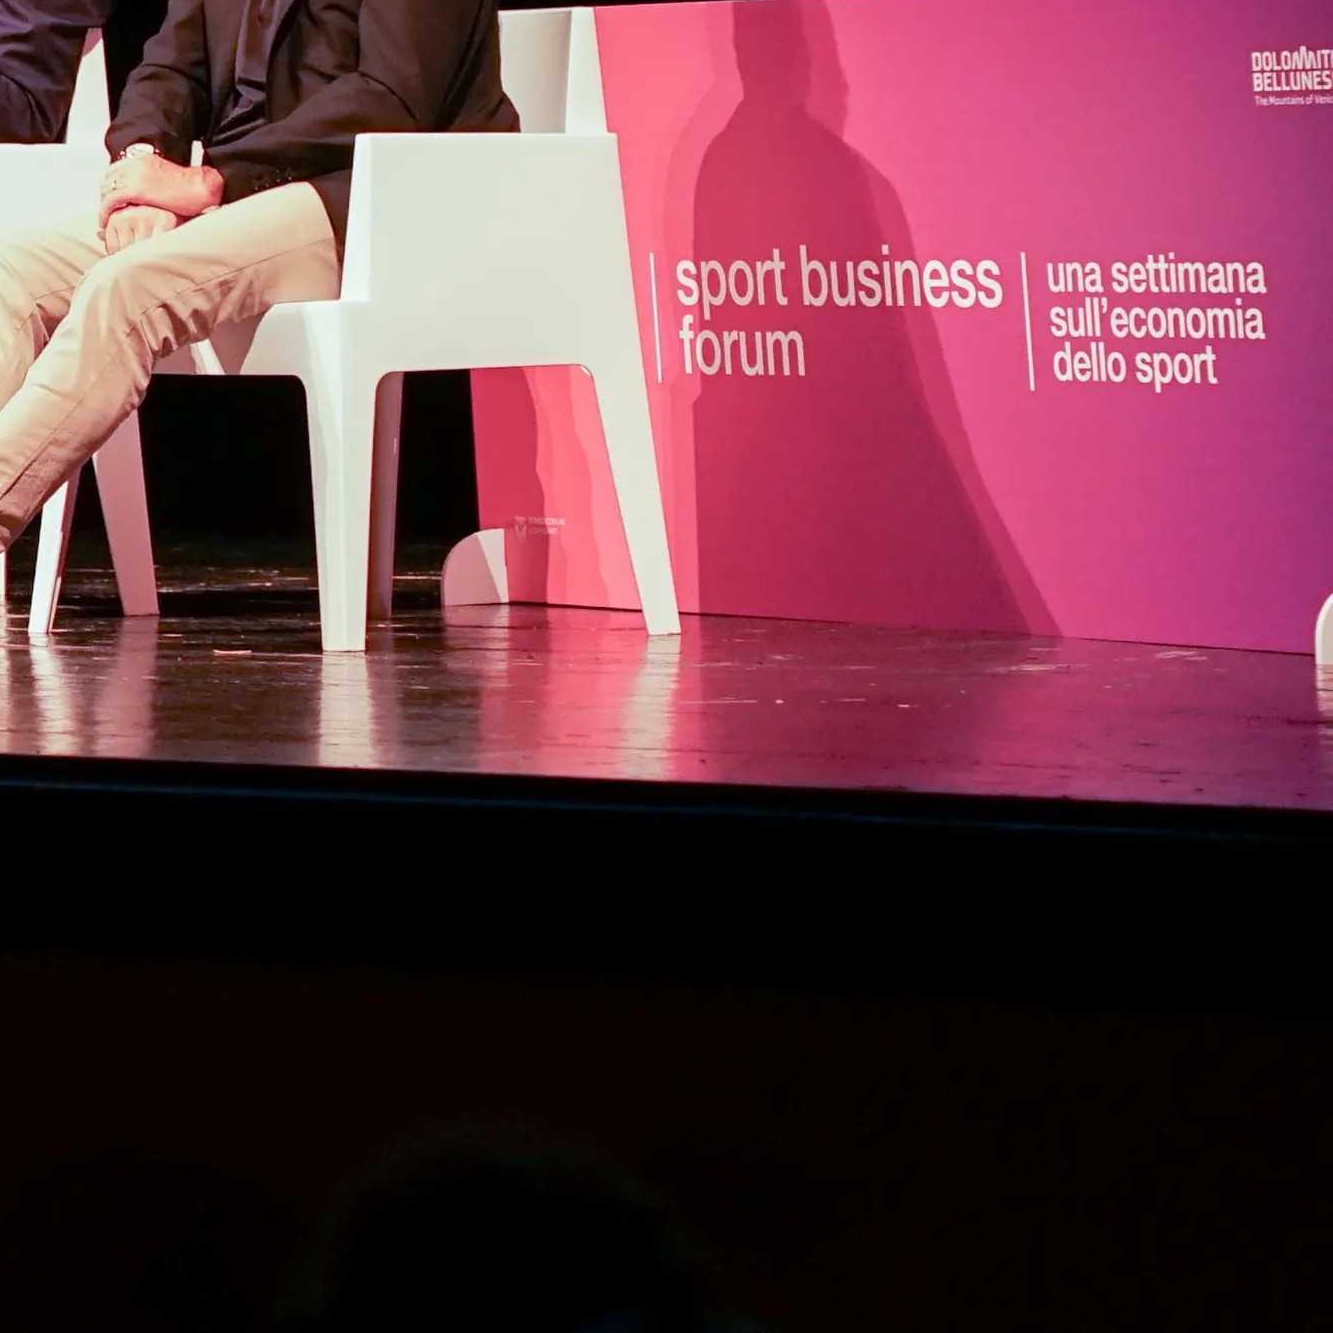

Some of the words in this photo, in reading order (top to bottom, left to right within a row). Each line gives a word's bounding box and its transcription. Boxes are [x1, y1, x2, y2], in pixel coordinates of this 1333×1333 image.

[1253, 70, 1333, 92] BELLUNES
[676, 248, 785, 320] sport
[800, 244, 1002, 309] business
[1047, 259, 1104, 294] una
[1112, 253, 1267, 294] settimana
[1050, 299, 1266, 341] sull'economia
[679, 314, 805, 377] forum
[1053, 340, 1127, 383] dello
[1135, 345, 1217, 392] sport
